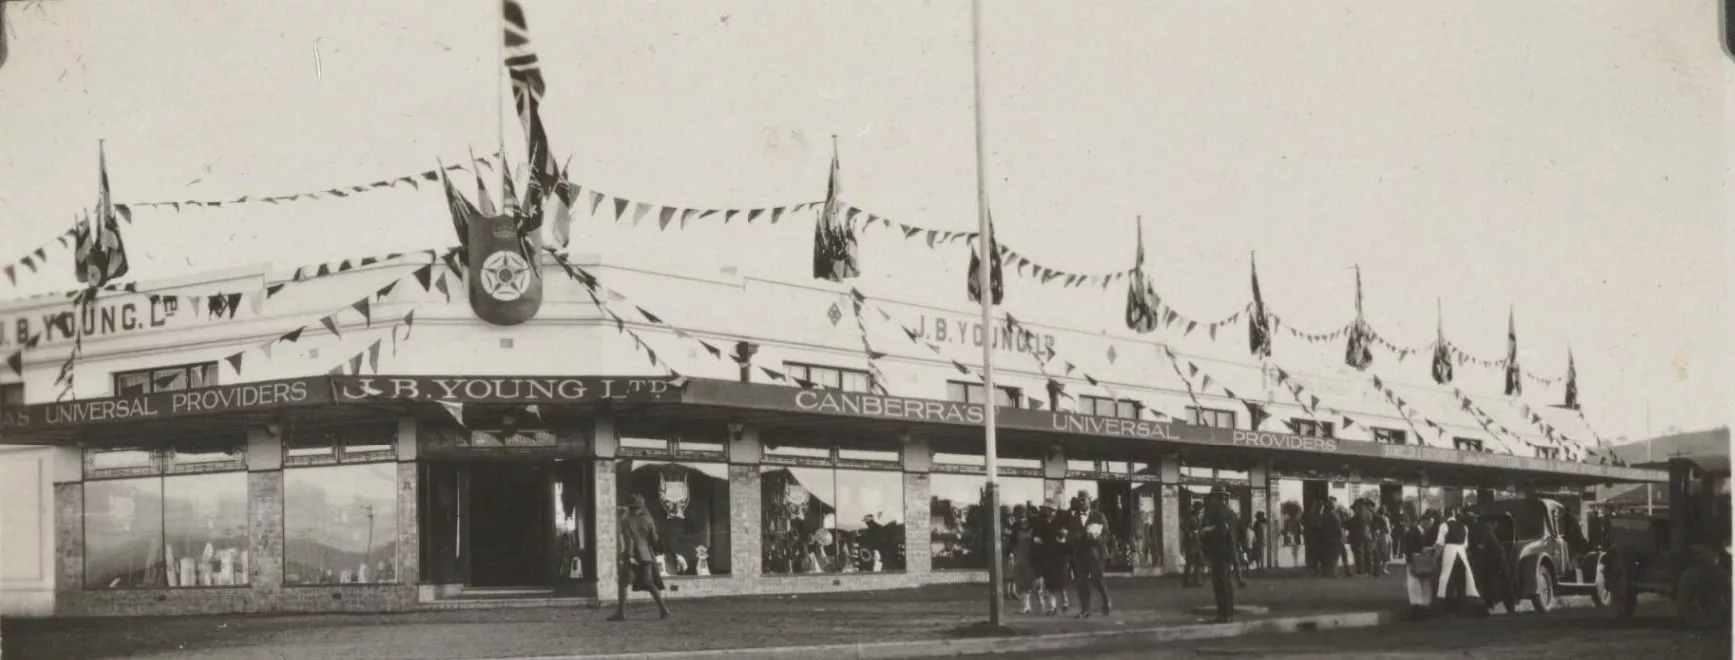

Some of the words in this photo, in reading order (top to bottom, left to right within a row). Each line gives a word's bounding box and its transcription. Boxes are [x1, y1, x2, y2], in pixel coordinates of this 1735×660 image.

[46, 396, 158, 424] UNIVERSAL
[172, 381, 307, 413] PROVIDERS
[795, 389, 984, 424] CANBERRA'S
[1052, 413, 1180, 441] UNIVERSAL
[1232, 429, 1336, 451] PROVIDERS
